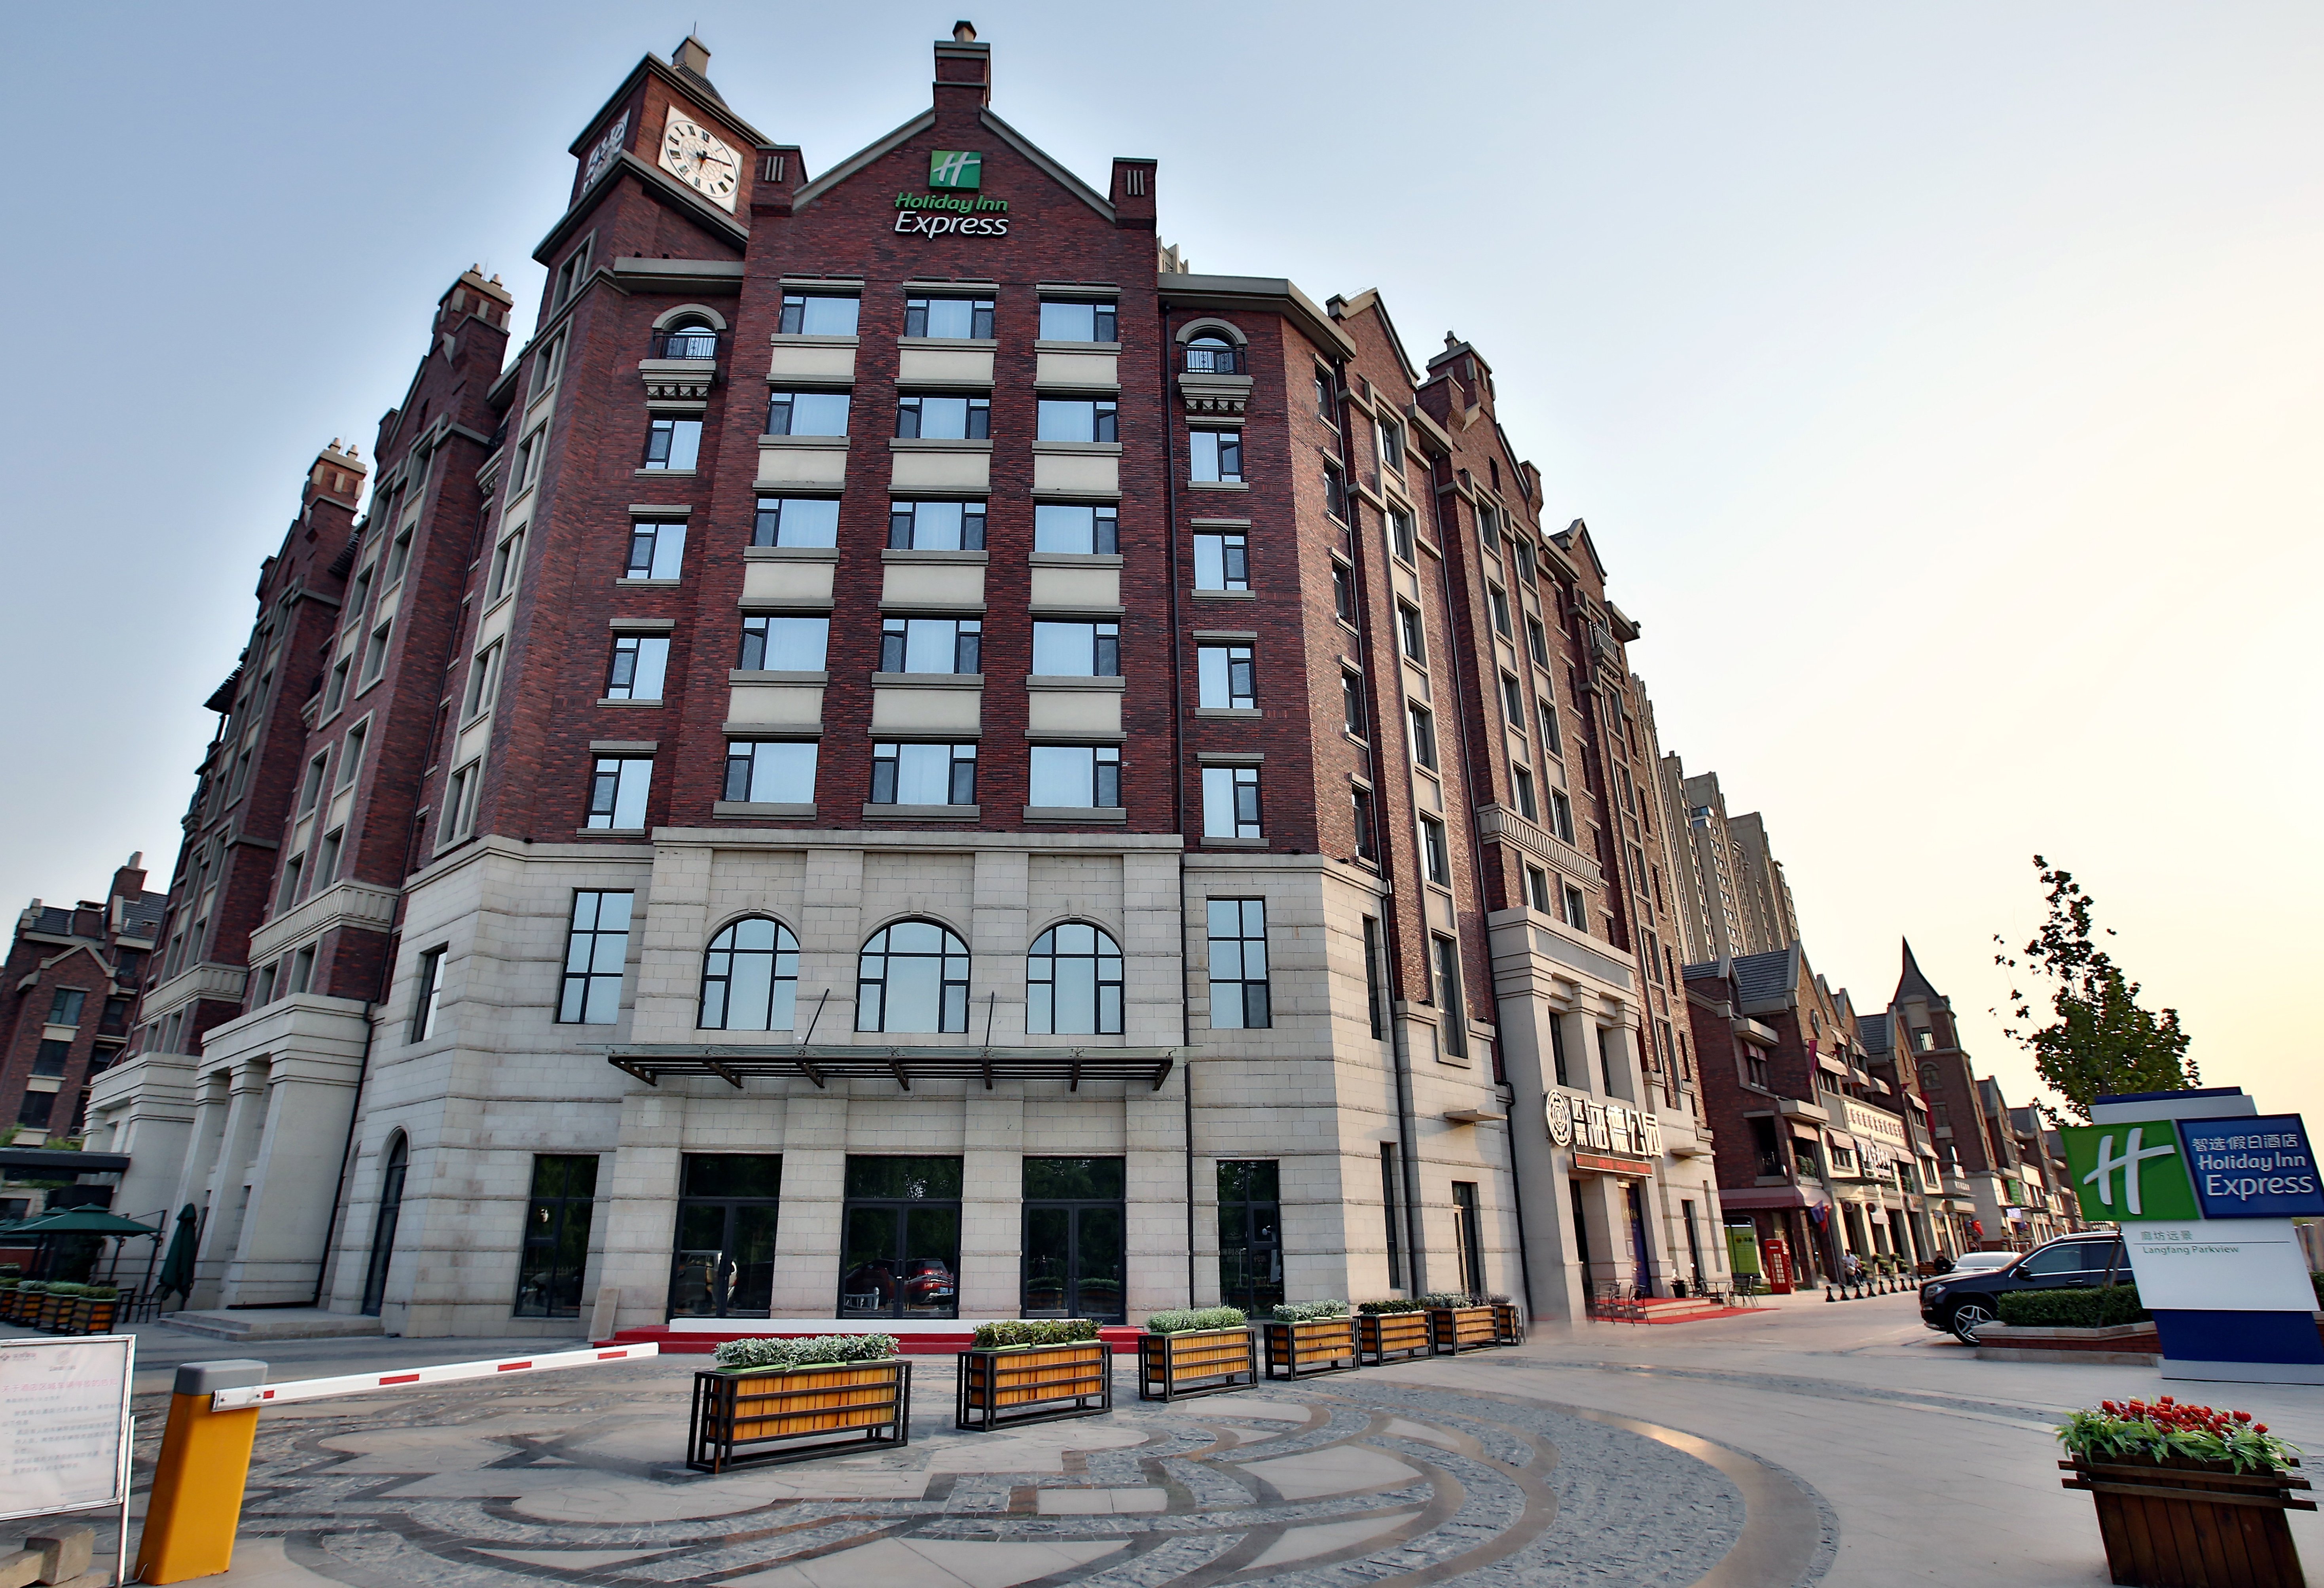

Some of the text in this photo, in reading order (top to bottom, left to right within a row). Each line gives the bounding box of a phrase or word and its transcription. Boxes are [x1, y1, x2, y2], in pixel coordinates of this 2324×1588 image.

[894, 191, 1008, 215] Holiday Inn
[895, 211, 1008, 239] Express
[2192, 1133, 2298, 1152] 智选假日酒店
[2198, 1151, 2306, 1171] Holiday Inn
[2206, 1174, 2315, 1201] Express
[2143, 1246, 2189, 1255] Langfang
